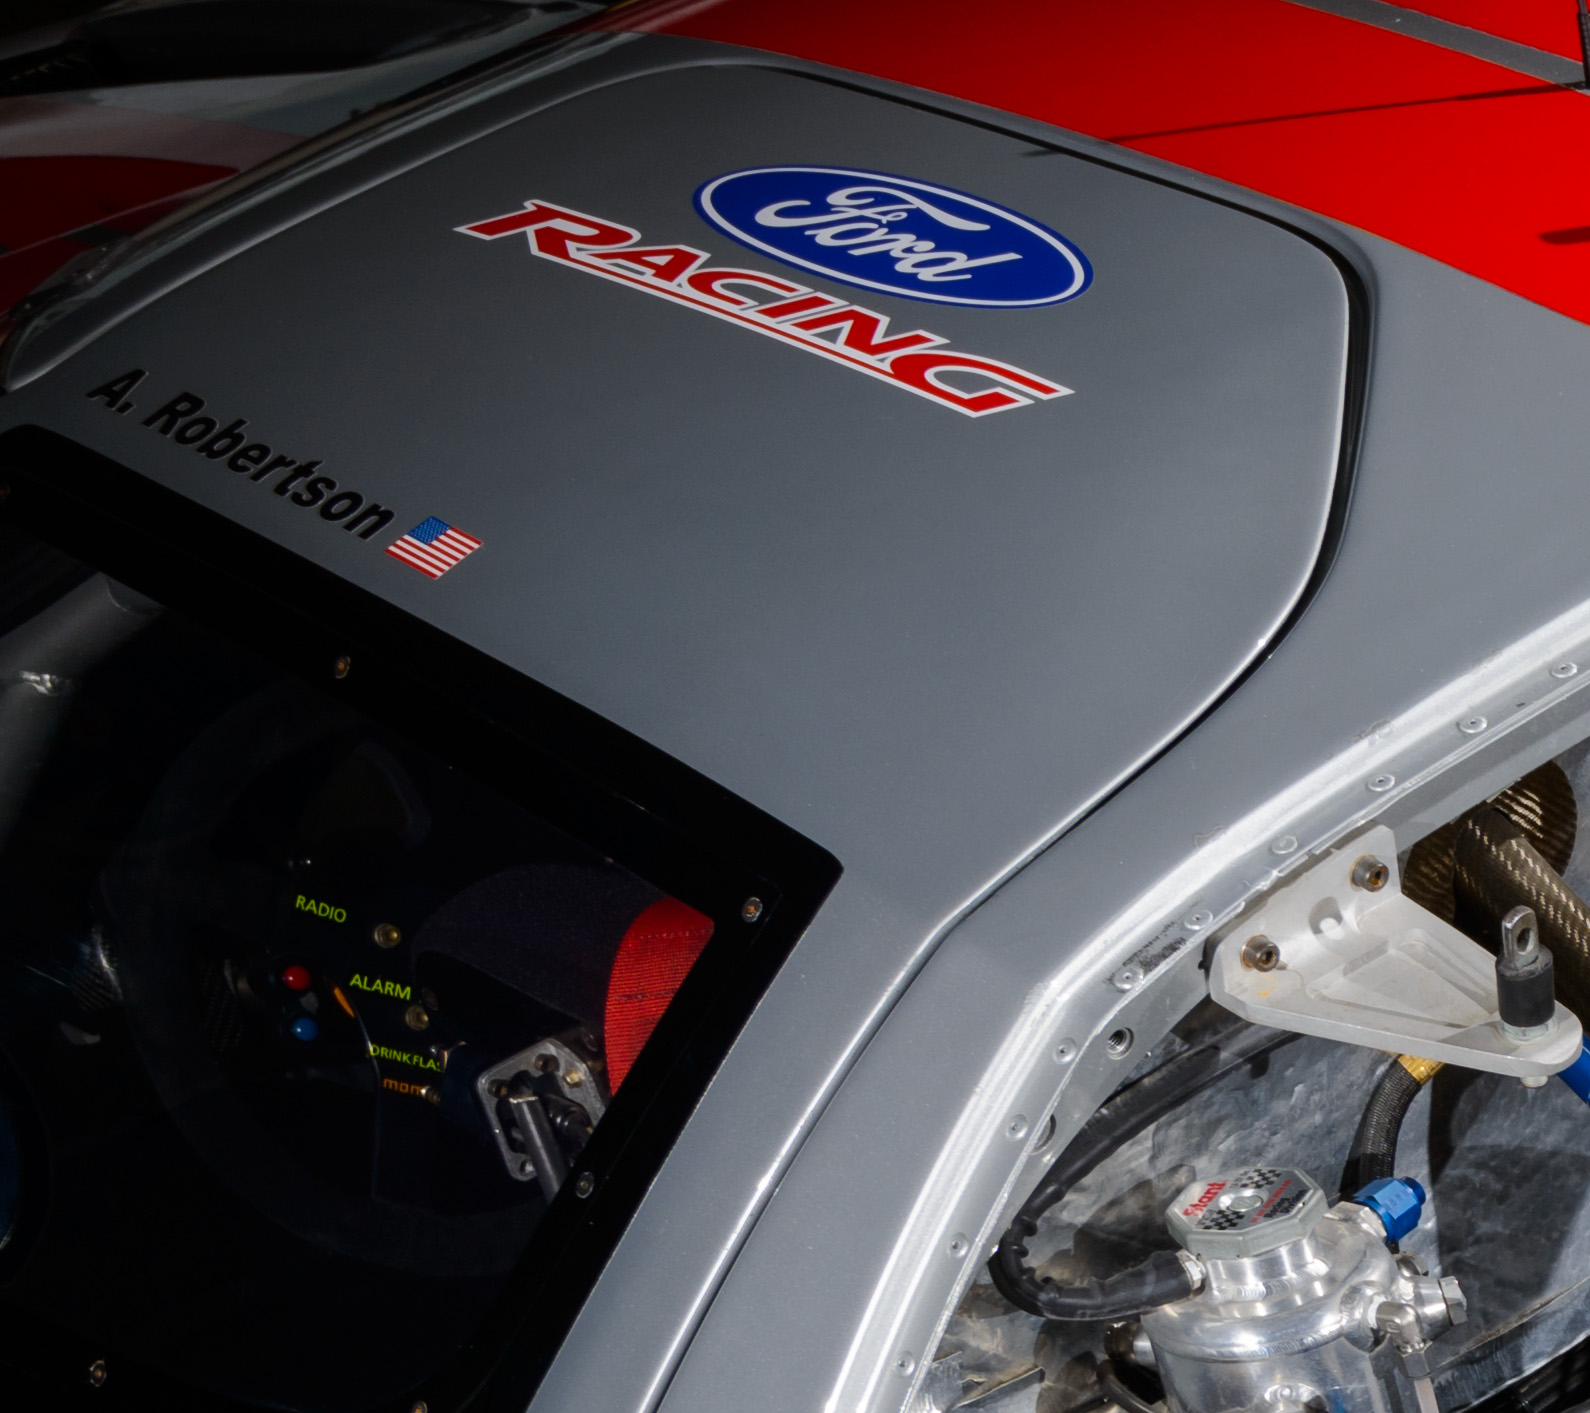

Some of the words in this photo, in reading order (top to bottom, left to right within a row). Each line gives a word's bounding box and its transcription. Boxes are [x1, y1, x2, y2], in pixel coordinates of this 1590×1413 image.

[755, 179, 1024, 286] Ford
[454, 199, 1075, 419] RACING
[87, 366, 147, 414] A.
[142, 389, 396, 545] Robertson
[295, 894, 347, 923] RADIO
[350, 973, 412, 1001] ALARM
[369, 1044, 411, 1065] DRINK
[1182, 1180, 1229, 1218] Stant
